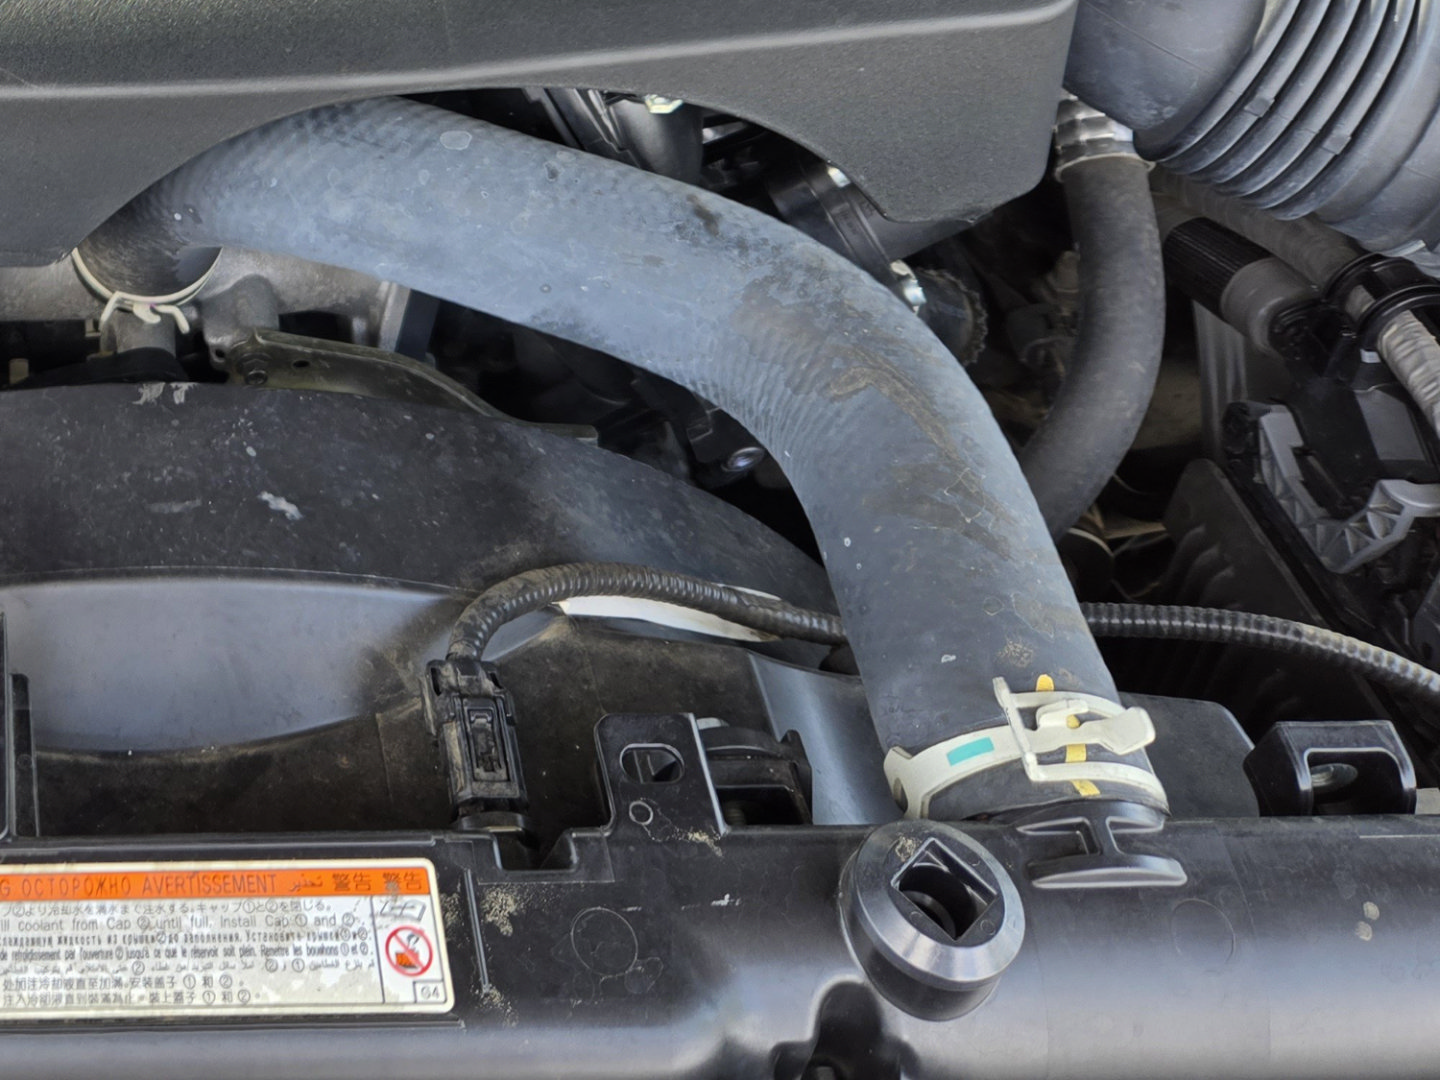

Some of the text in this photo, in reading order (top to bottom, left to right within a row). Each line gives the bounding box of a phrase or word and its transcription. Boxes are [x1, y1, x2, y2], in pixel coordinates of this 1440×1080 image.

[20, 874, 133, 897] ОСТОРОЖНО
[142, 872, 279, 896] AVERTISSEMENT
[17, 918, 64, 931] coolant
[71, 916, 99, 930] from
[106, 916, 132, 931] Cap
[155, 915, 182, 929] until
[191, 915, 213, 928] full.
[219, 915, 257, 928] Install
[264, 914, 290, 928] Cap
[313, 913, 337, 927] and
[0, 950, 8, 961] de
[64, 949, 76, 961] par
[153, 948, 161, 959] ce
[164, 948, 178, 960] que
[223, 945, 236, 958] soit
[260, 944, 290, 957] Remettre
[293, 944, 303, 957] les
[306, 942, 339, 957] bouchons
